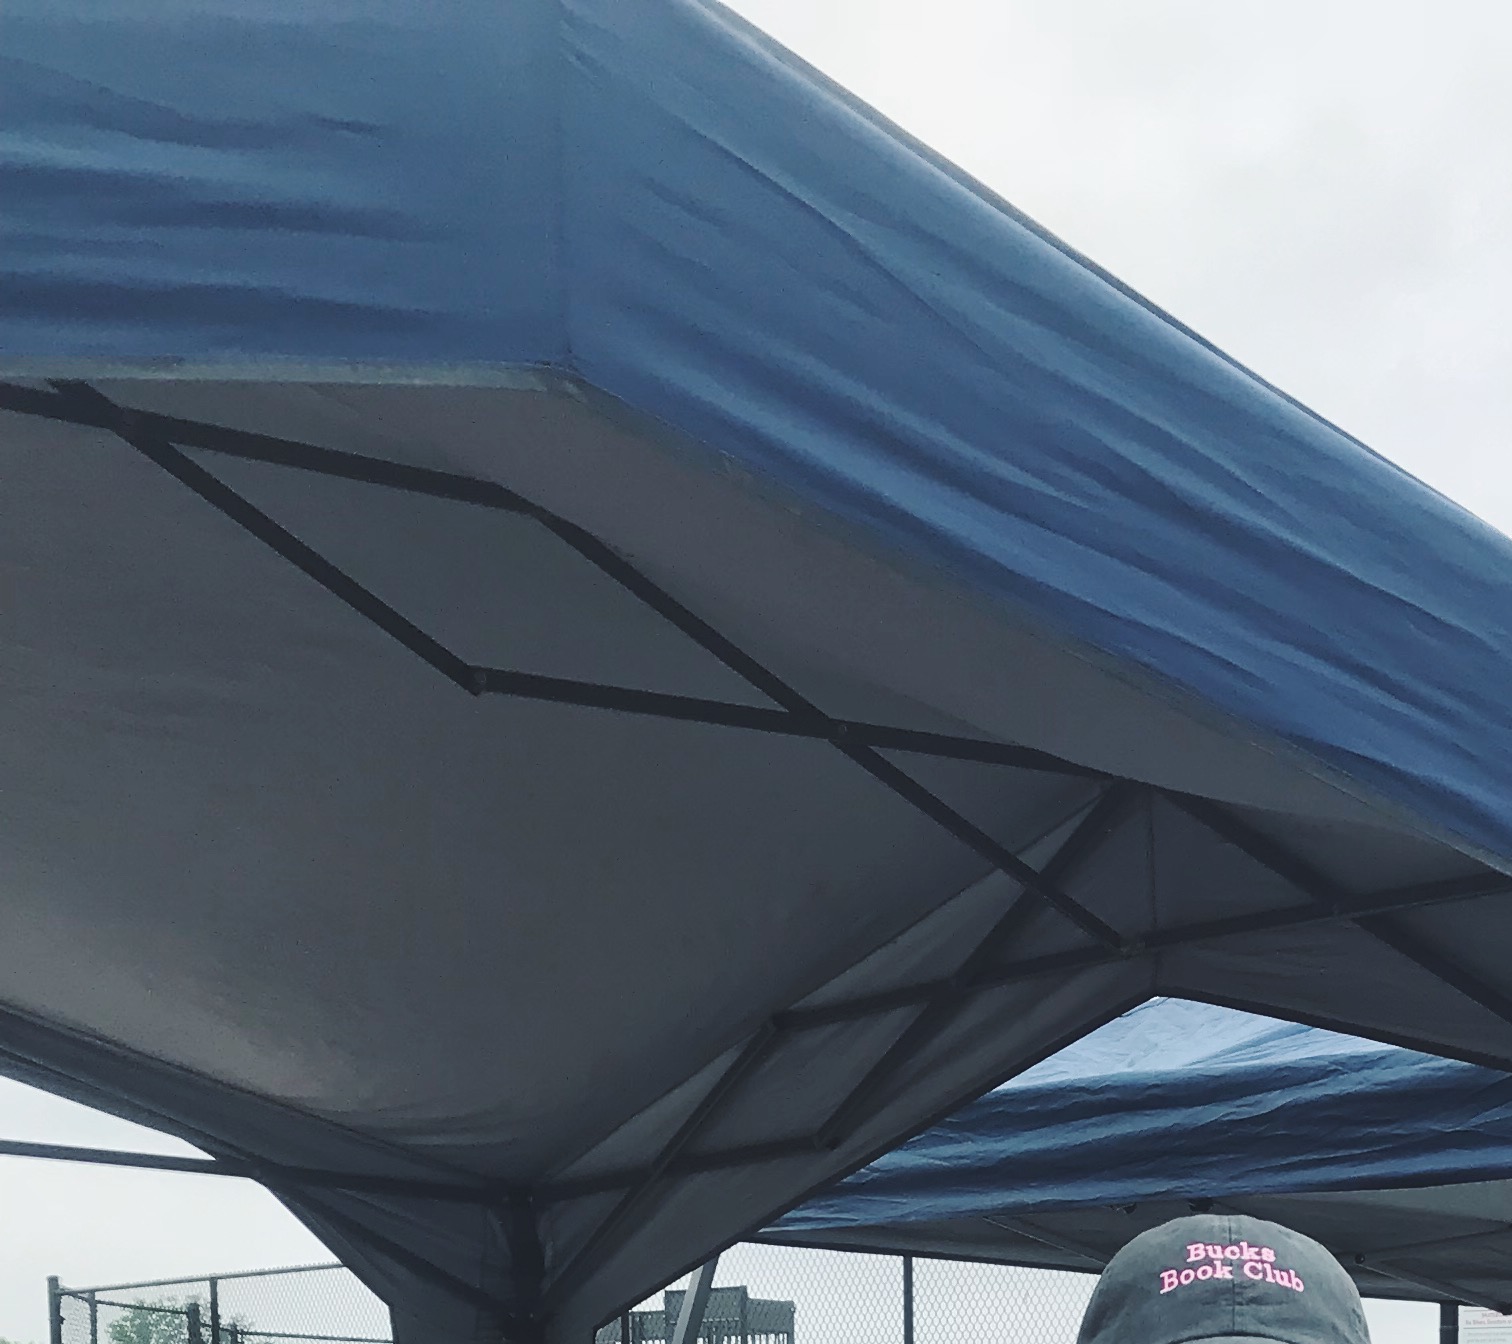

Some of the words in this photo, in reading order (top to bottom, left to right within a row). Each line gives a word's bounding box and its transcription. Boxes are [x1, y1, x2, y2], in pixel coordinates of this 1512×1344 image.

[1186, 1241, 1276, 1262] Bucks
[1160, 1260, 1234, 1294] Book
[1243, 1261, 1305, 1292] Club
